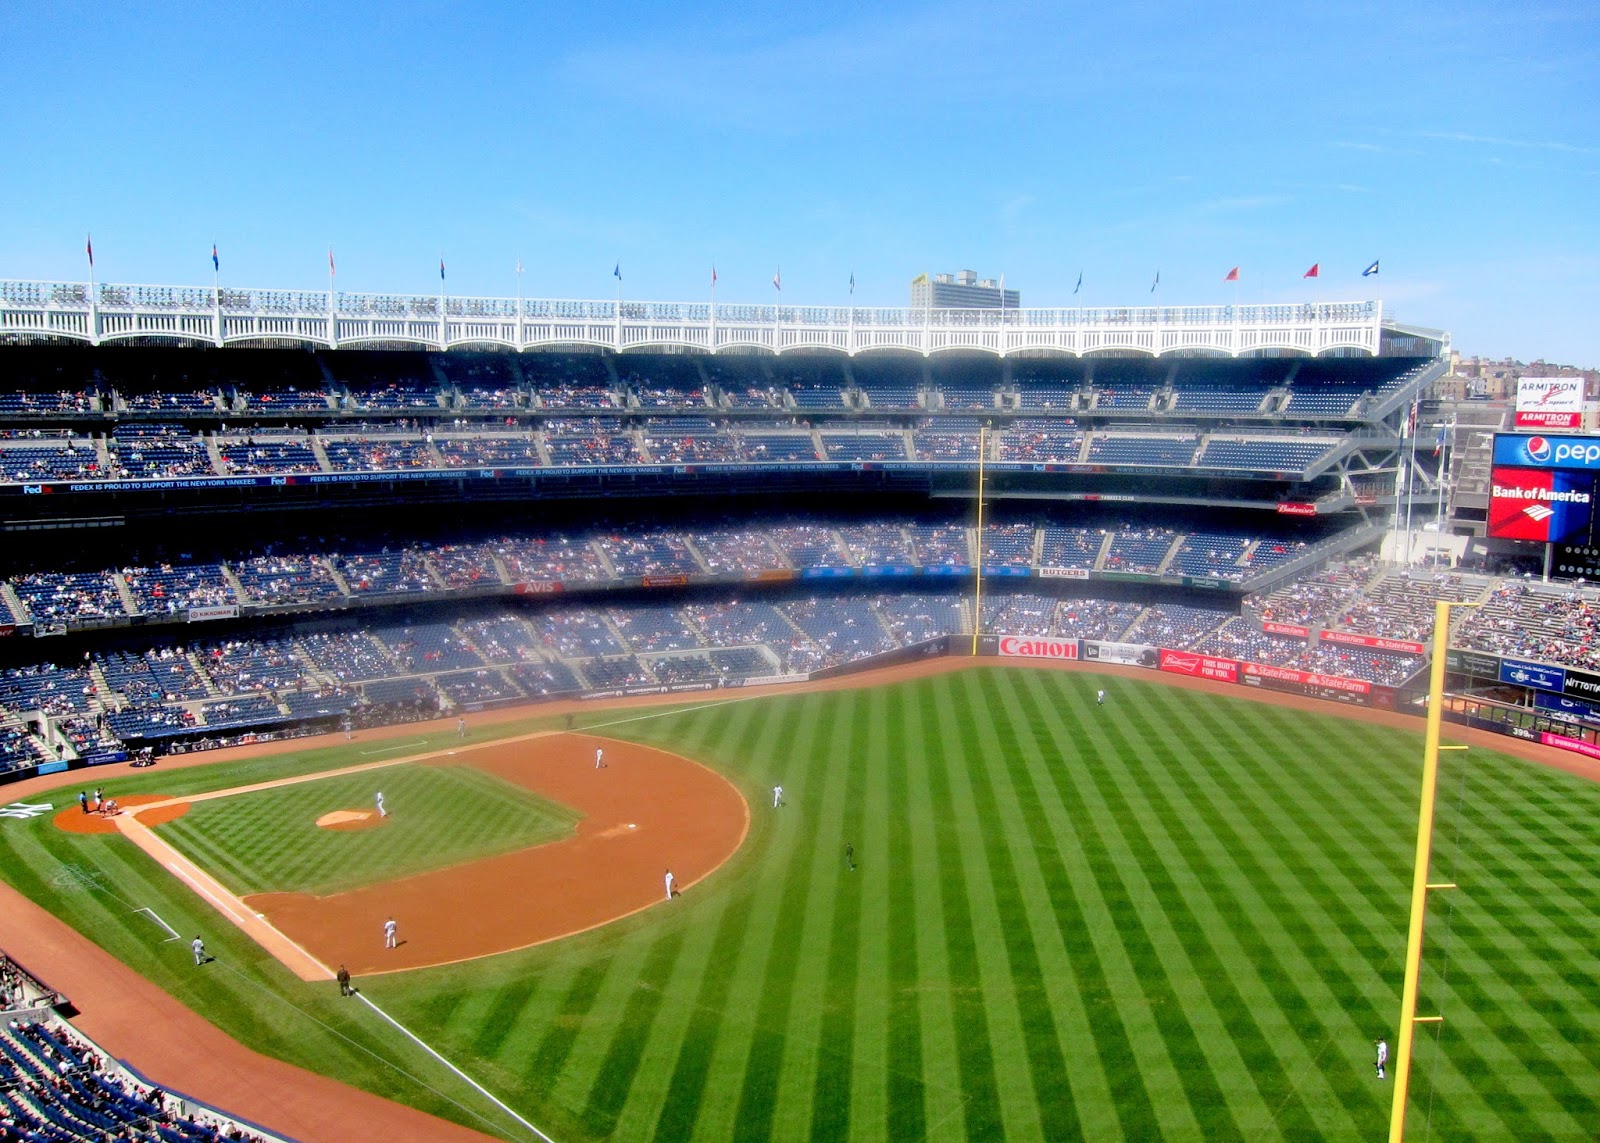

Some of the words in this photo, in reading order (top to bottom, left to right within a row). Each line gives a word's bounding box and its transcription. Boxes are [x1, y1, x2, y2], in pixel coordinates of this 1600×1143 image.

[1521, 383, 1577, 391] ARMITRON
[1521, 413, 1571, 421] ARMITRON
[142, 481, 174, 489] SUPPORT
[1492, 485, 1524, 499] Bank
[1524, 487, 1538, 500] of
[1538, 488, 1590, 503] America
[1278, 503, 1314, 513] Budweiser
[1042, 569, 1086, 577] RUTGERS
[524, 582, 554, 593] AVIS
[1275, 625, 1289, 634] State
[1288, 627, 1305, 635] Farm
[1335, 633, 1350, 642] State
[1350, 636, 1365, 644] Farm
[1000, 637, 1077, 658] Canon
[1385, 641, 1400, 649] State
[1400, 643, 1417, 651] Farm
[1202, 659, 1216, 668] THIS
[1217, 661, 1236, 671] BUD'S
[1202, 667, 1214, 676] FOR
[1214, 669, 1229, 678] YOU.
[1257, 666, 1278, 678] State
[1278, 669, 1299, 681] Farm
[1320, 676, 1342, 688] State
[1342, 679, 1365, 692] Farm
